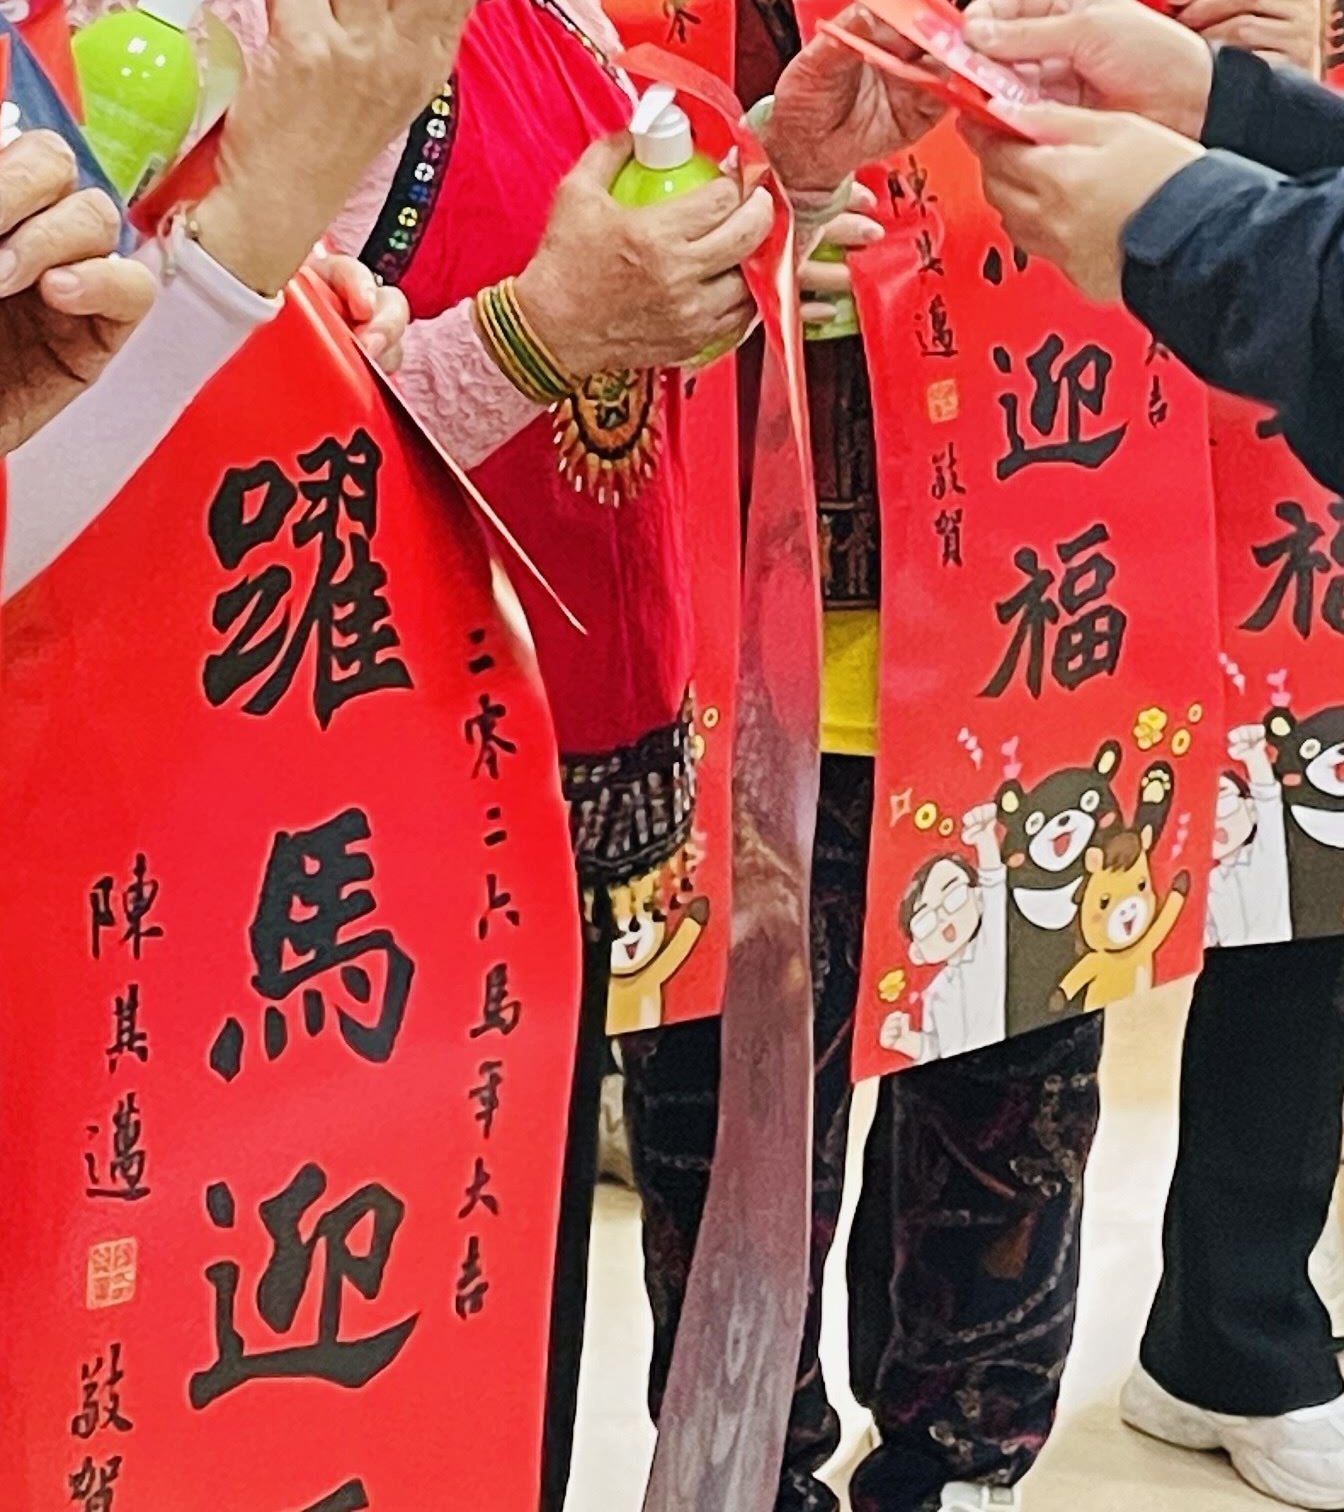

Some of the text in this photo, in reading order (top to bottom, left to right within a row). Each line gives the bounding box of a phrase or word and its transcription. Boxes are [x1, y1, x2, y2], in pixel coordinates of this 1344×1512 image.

[85, 853, 165, 1202] 陳其邁
[190, 427, 423, 1512] 躍馬迎
